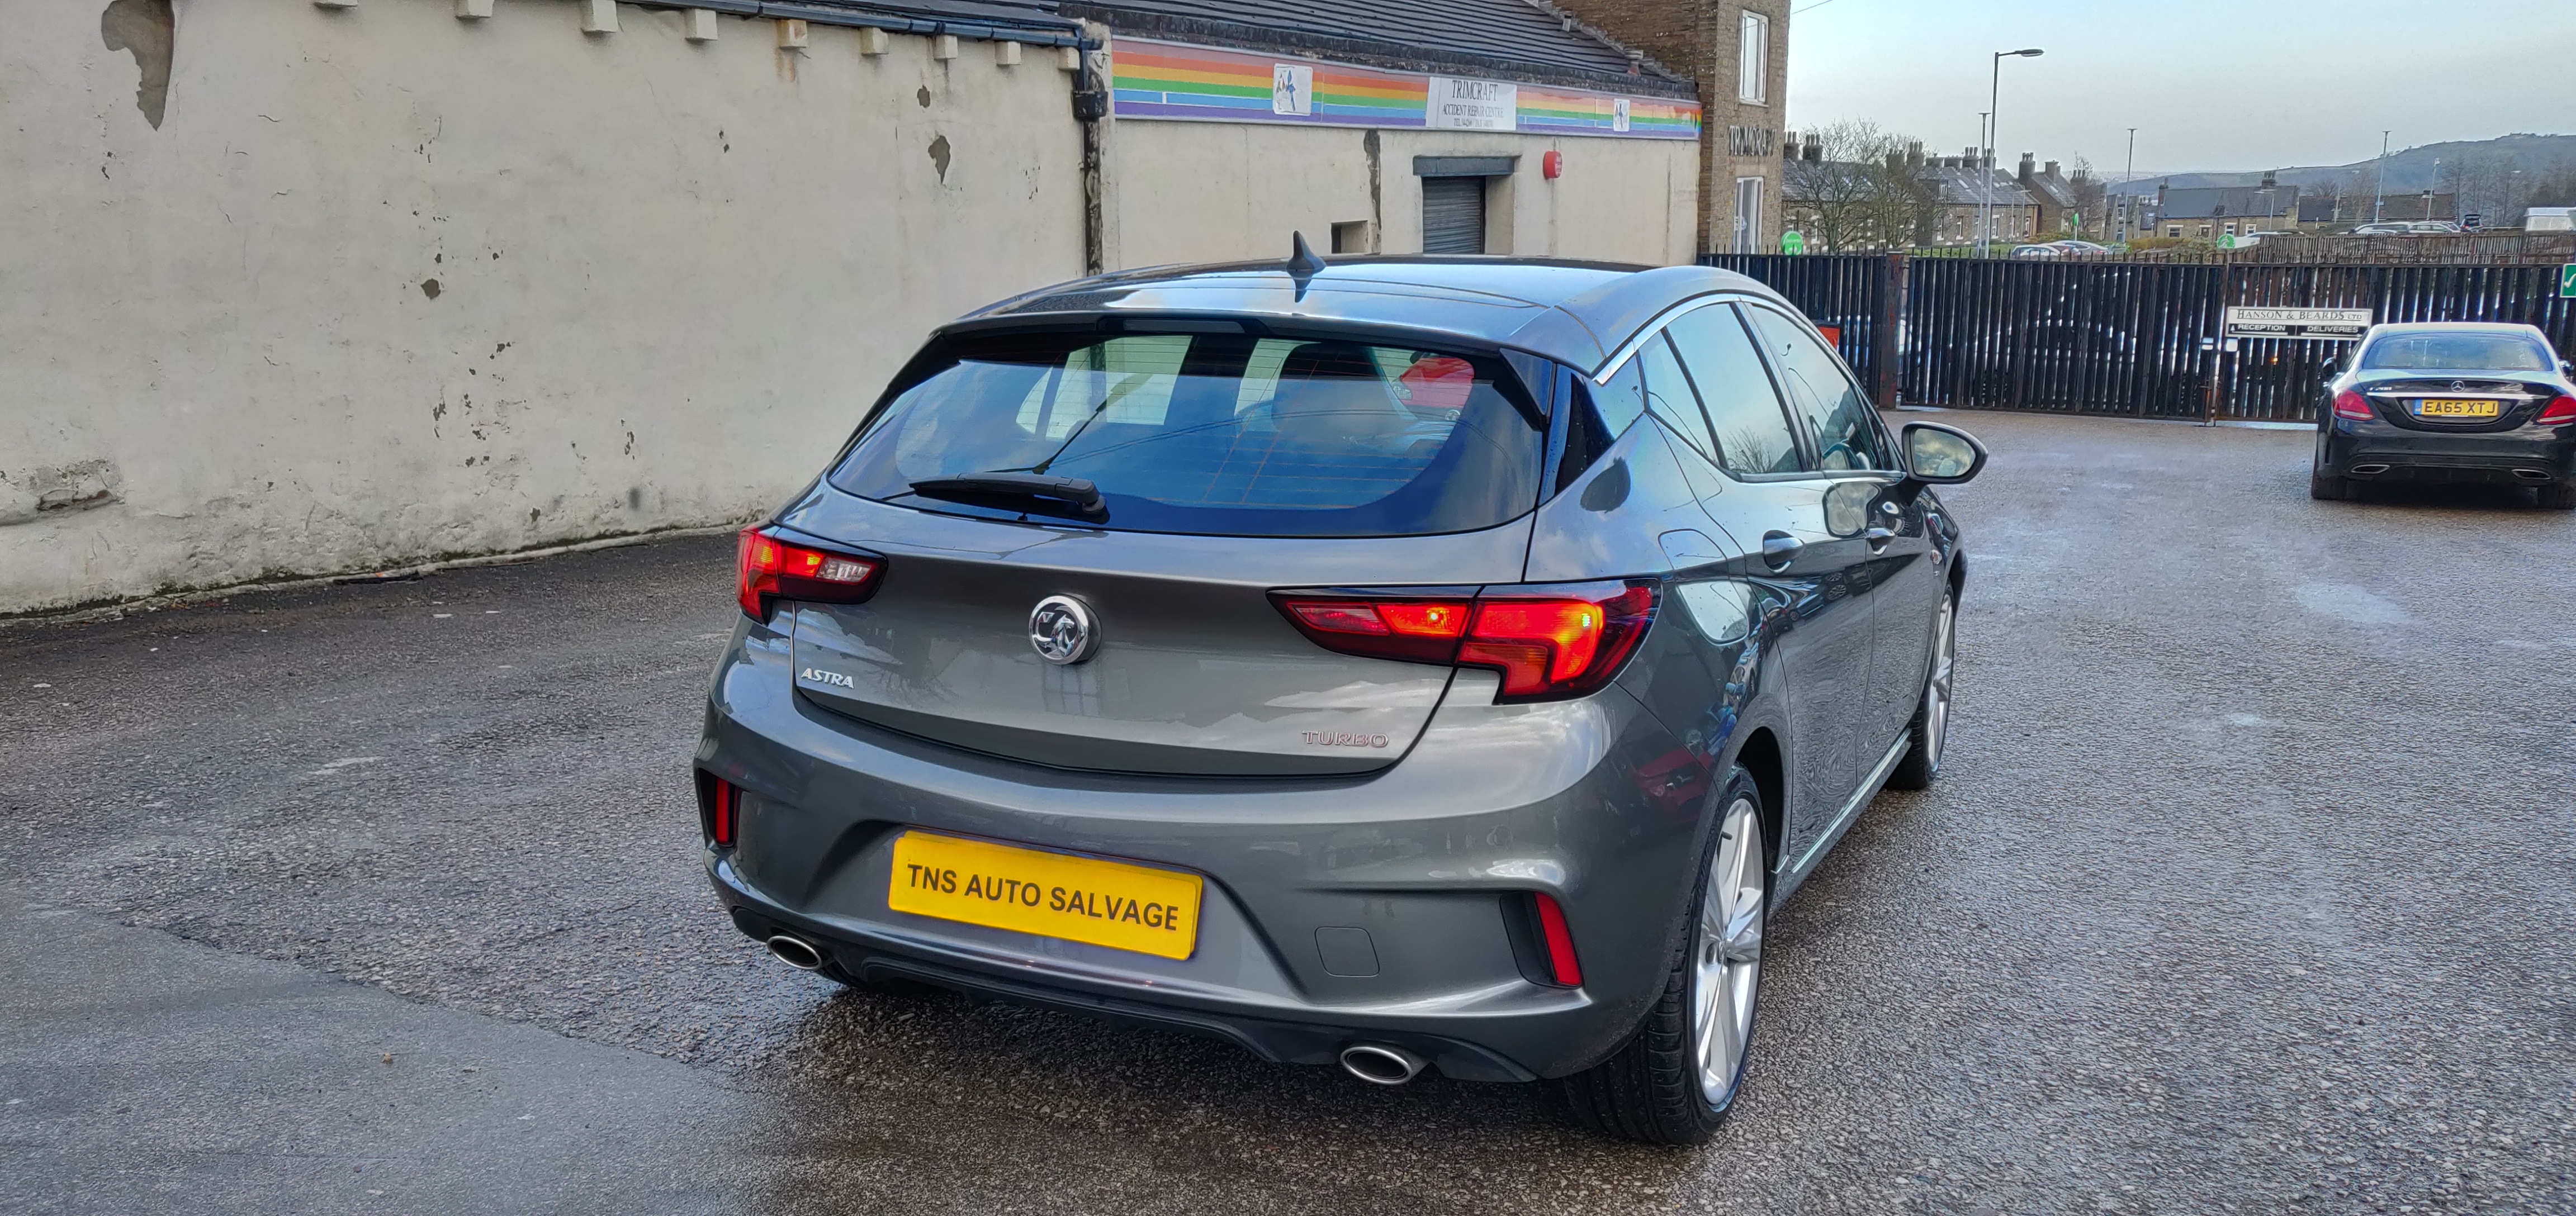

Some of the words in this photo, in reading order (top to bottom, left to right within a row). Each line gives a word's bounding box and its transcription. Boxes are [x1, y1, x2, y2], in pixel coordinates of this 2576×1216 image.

[1452, 80, 1498, 101] TRIMCRAFT
[1443, 103, 1467, 116] ACCIDENT
[1467, 105, 1485, 117] REPAIR
[1485, 106, 1504, 118] CENTRE
[2237, 310, 2283, 320] HANSON
[2286, 311, 2294, 320] &
[2299, 311, 2345, 321] BEARDS
[2425, 402, 2463, 414] EA65
[2466, 402, 2495, 414] XTJ
[801, 668, 854, 690] ASTRA
[1302, 730, 1389, 748] TURBO
[907, 863, 957, 894] TNS
[964, 874, 1041, 906] AUTO
[1049, 886, 1178, 931] SALVAGE
